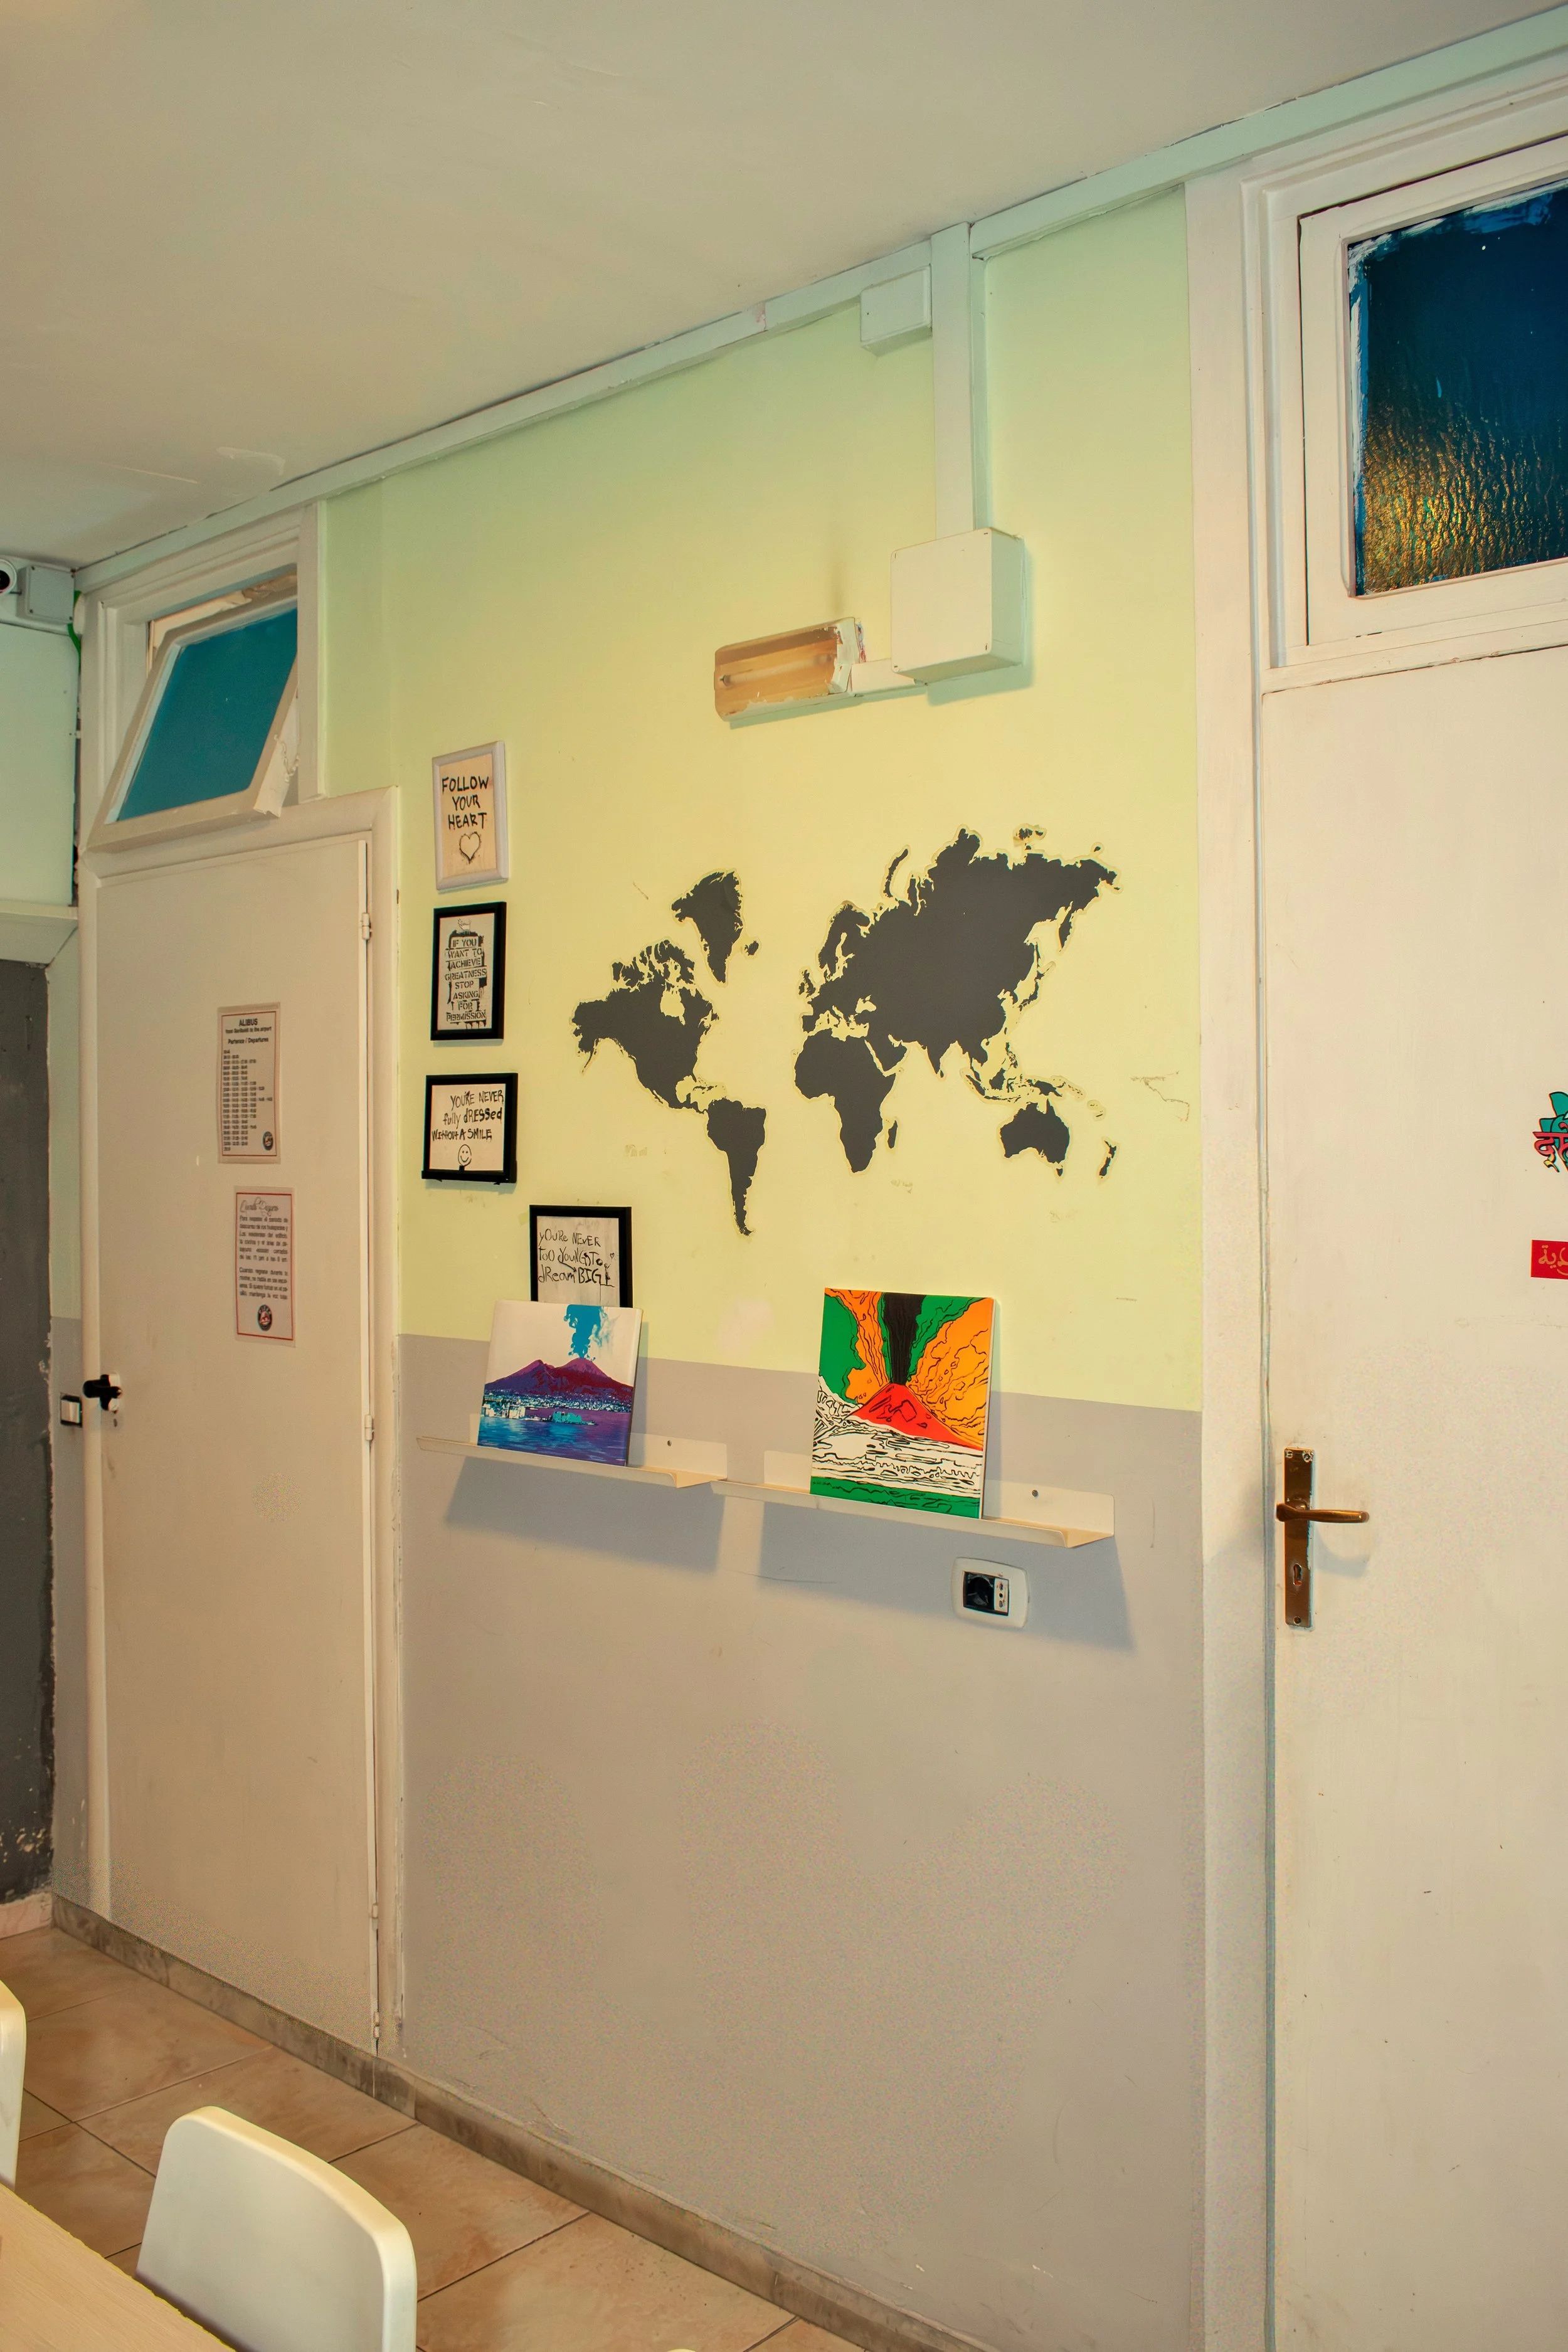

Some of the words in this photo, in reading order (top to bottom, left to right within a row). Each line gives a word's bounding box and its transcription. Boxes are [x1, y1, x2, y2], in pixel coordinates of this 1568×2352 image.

[442, 775, 489, 793] FOLLOW
[452, 794, 480, 811] YOUR
[448, 812, 487, 830] HEART
[452, 939, 459, 948] IF
[461, 938, 477, 947] YOU
[447, 948, 469, 958] WANT
[472, 948, 482, 957] TO
[450, 957, 481, 969] ACHIEVE
[445, 968, 487, 981] GREATNESS
[455, 980, 474, 989] STOP
[453, 990, 479, 1000] ASKING
[458, 1002, 473, 1010] FOR
[446, 1010, 486, 1022] PERMISSION
[238, 1018, 258, 1027] ALIBUS
[479, 1089, 504, 1103] NEVER
[442, 1112, 462, 1129] fully
[459, 1128, 467, 1140] A
[467, 1128, 492, 1140] SMILE
